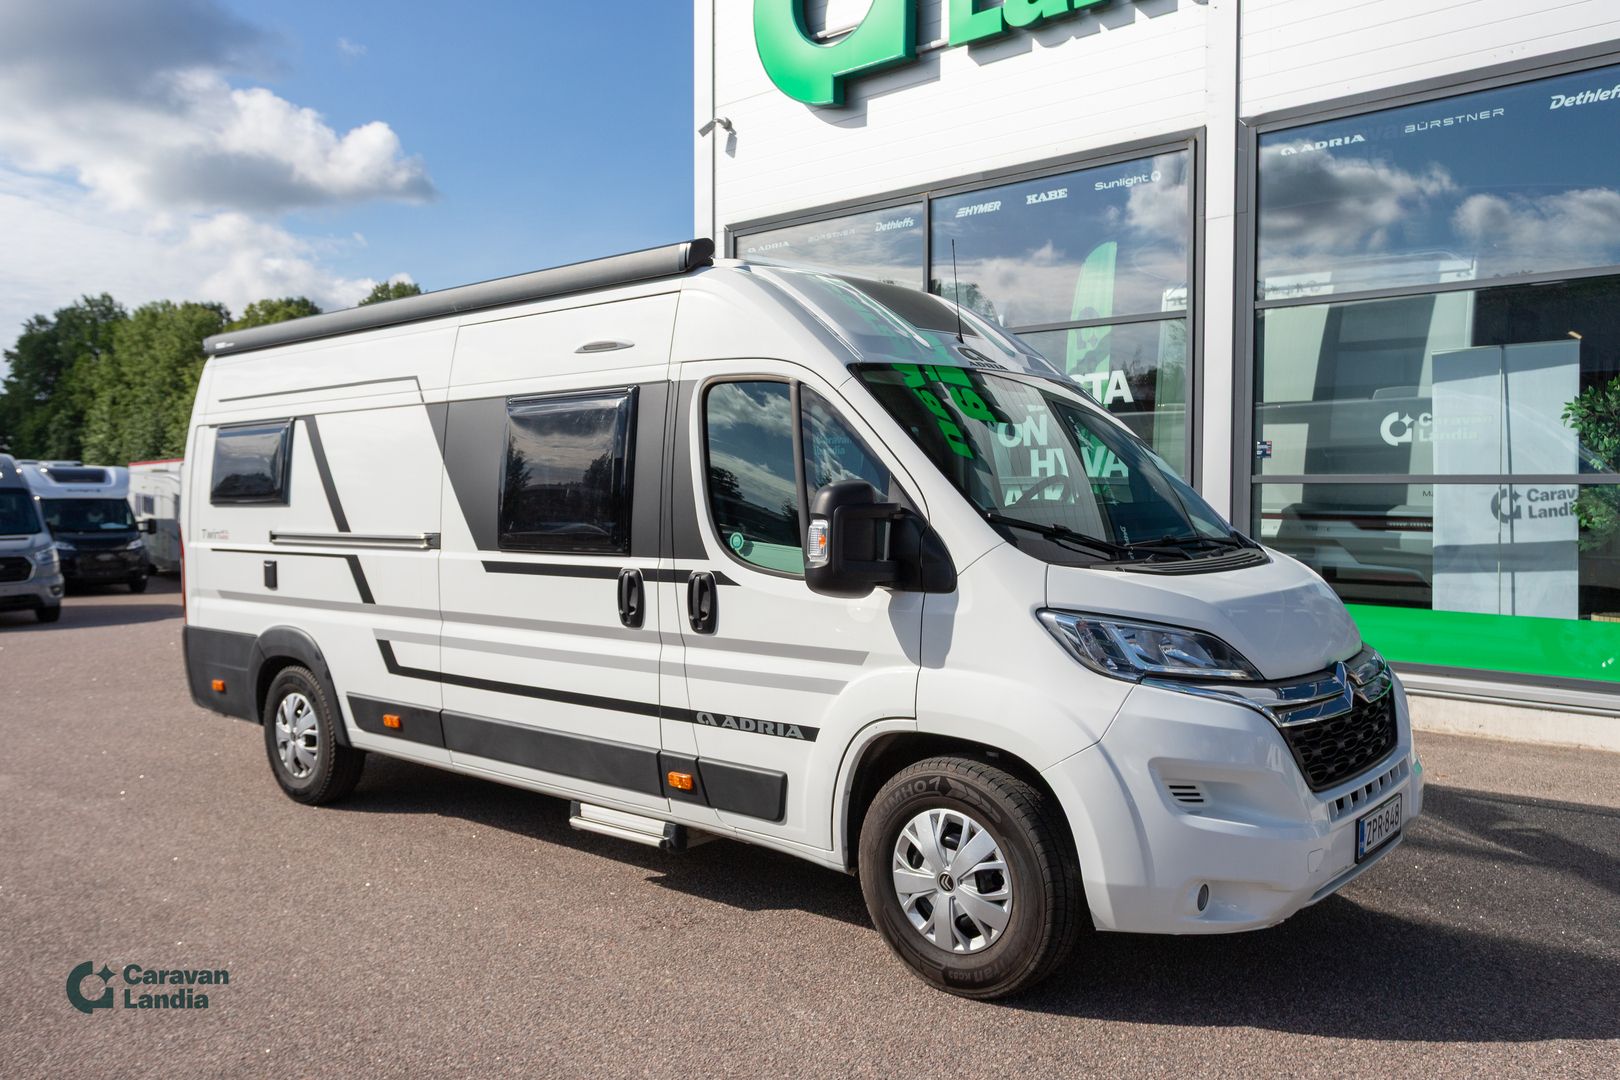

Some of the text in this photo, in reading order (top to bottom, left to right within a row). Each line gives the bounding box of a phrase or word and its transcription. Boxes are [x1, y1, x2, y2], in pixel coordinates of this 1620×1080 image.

[1299, 134, 1366, 154] ADRIA
[1404, 107, 1505, 134] BÜRSTNER
[1550, 84, 1620, 110] Dethlef
[956, 174, 1149, 218] HYMER KABE Sunlight
[874, 216, 914, 232] Dethleffs
[1526, 487, 1576, 503] Carav
[1528, 502, 1574, 519] Landi
[721, 715, 806, 740] ADRIA
[1366, 802, 1400, 847] ZPR-848
